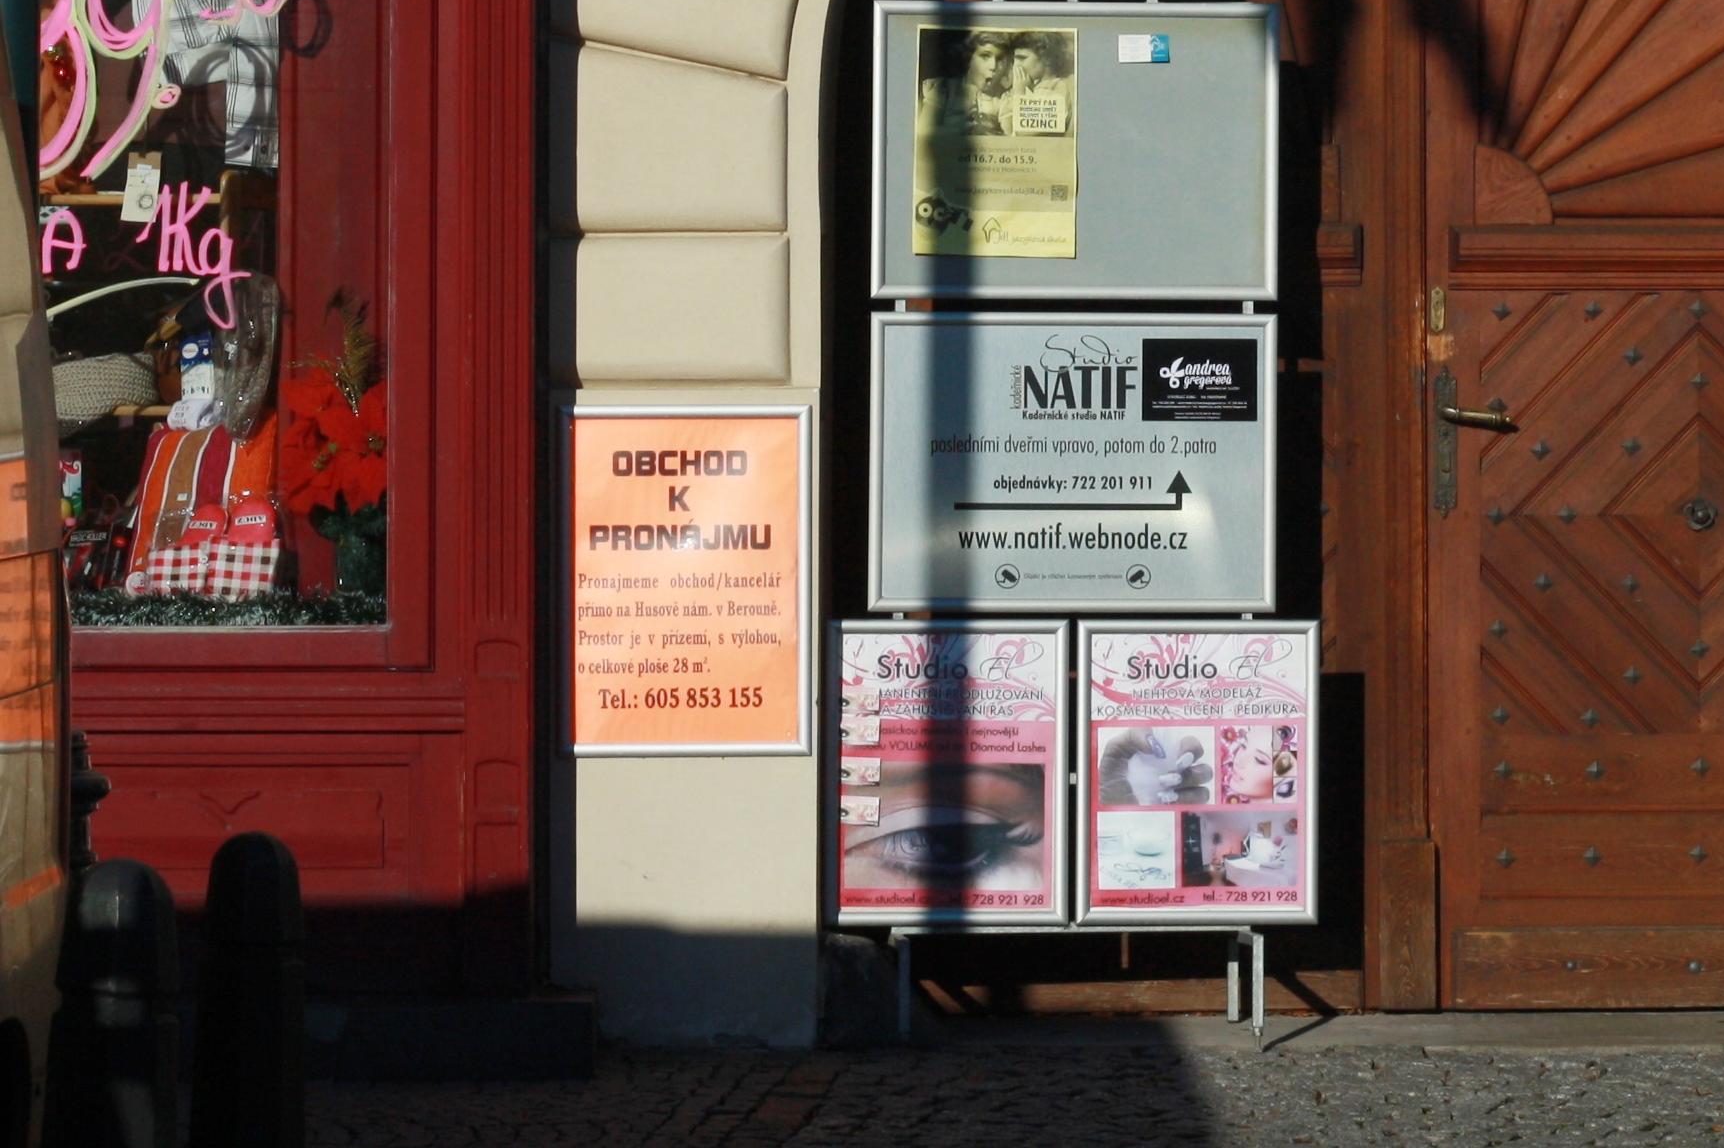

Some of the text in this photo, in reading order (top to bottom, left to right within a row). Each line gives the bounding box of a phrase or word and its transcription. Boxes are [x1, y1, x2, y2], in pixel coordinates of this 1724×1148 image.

[1020, 118, 1057, 129] CIZINCI
[974, 154, 997, 164] 16.7.
[999, 155, 1012, 164] do
[1014, 155, 1038, 164] 15.9.
[1040, 334, 1138, 373] Studio
[1185, 358, 1231, 376] andrea
[1023, 365, 1138, 410] NATIF
[1071, 410, 1098, 421] studio
[1100, 410, 1126, 421] NATIF
[930, 434, 1000, 455] posledními
[1003, 434, 1049, 454] dveřmi
[1052, 439, 1099, 456] vpravo,
[1104, 438, 1145, 456] potom
[1150, 435, 1166, 454] do
[612, 450, 748, 477] OBCHOD
[993, 475, 1153, 493] objednávky: 722 201 911
[668, 486, 691, 512] K
[589, 519, 772, 551] PRONÁJMU
[958, 523, 1189, 551] www.natif.webnode.cz
[578, 571, 782, 593] Pronajmeme obchod/kancelář
[578, 601, 782, 624] přímo na Husově nám. v Berouně.
[578, 630, 782, 650] Prostor je v přízemí, s výlohou,
[578, 662, 585, 674] o
[588, 658, 635, 674] celkové
[638, 658, 669, 677] ploše
[673, 658, 689, 674] 28
[877, 654, 969, 679] Studio
[1126, 655, 1218, 680] Studio
[598, 686, 764, 710] Tel.: 605 853 155
[970, 742, 1015, 752] Diamond
[1017, 742, 1047, 753] Lashes
[971, 893, 994, 905] 728
[998, 893, 1018, 905] 921
[1023, 893, 1045, 905] 928
[1226, 890, 1248, 902] 728
[1251, 890, 1272, 902] 921
[1276, 890, 1298, 902] 928
